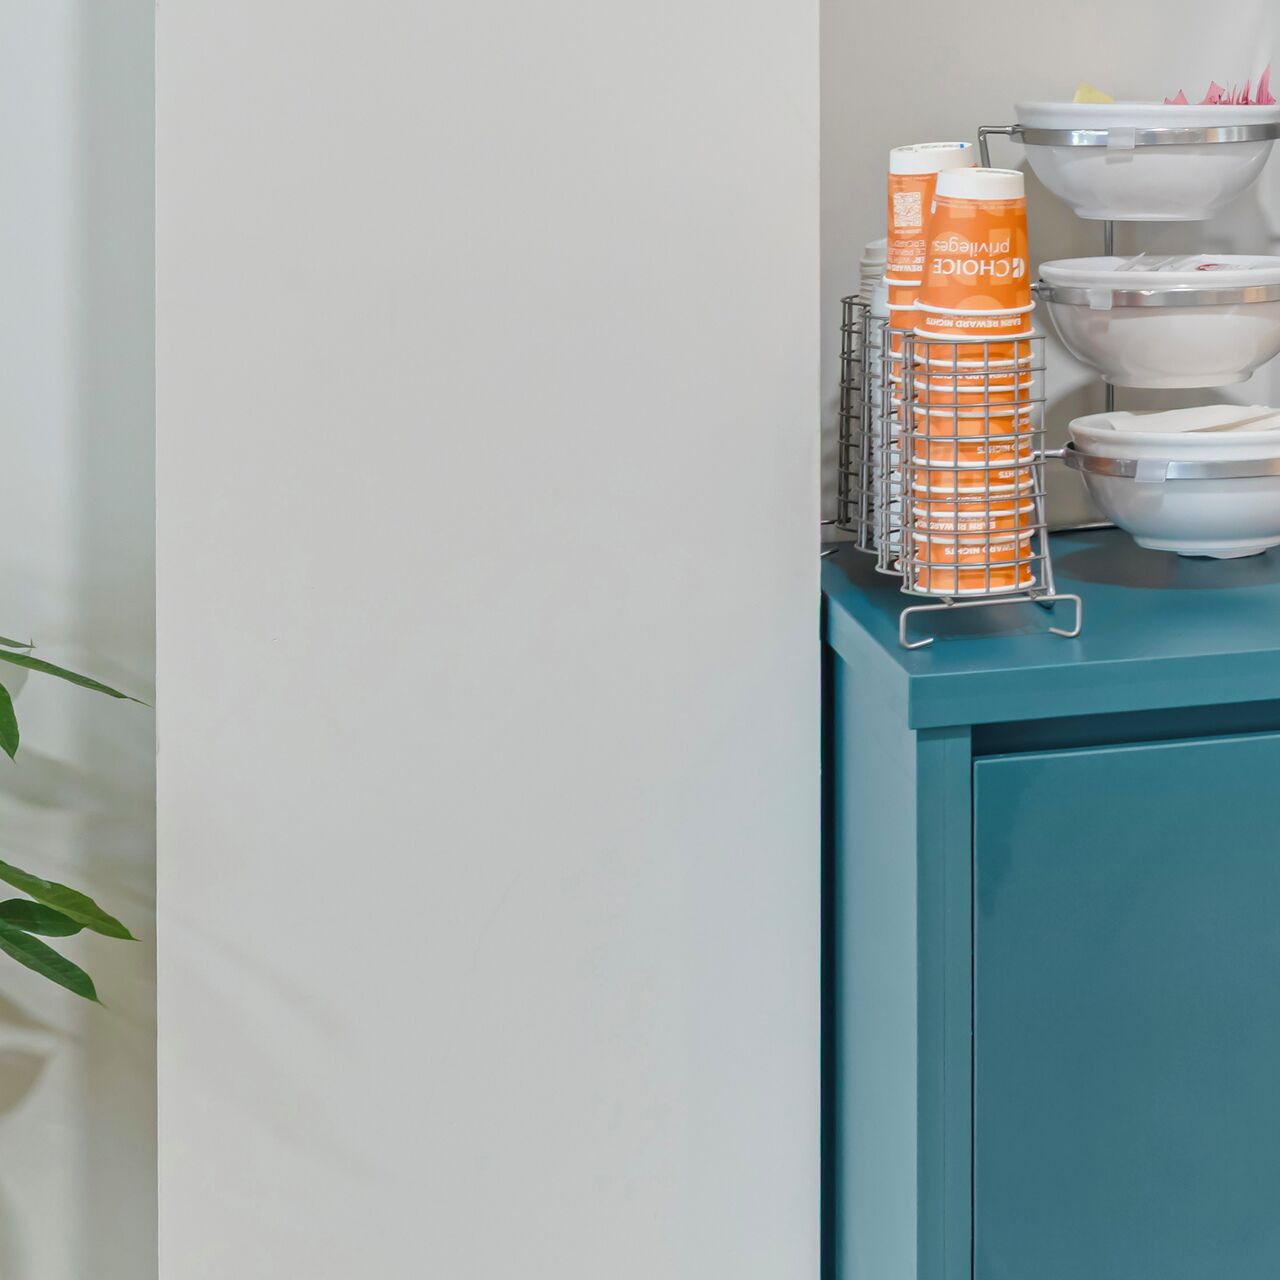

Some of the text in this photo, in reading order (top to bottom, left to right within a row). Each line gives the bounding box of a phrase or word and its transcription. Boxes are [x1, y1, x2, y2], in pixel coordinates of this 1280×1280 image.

[933, 236, 1010, 258] privileges
[932, 258, 1010, 278] CHOICE
[926, 317, 1022, 328] EARN REWARD NIGHTS
